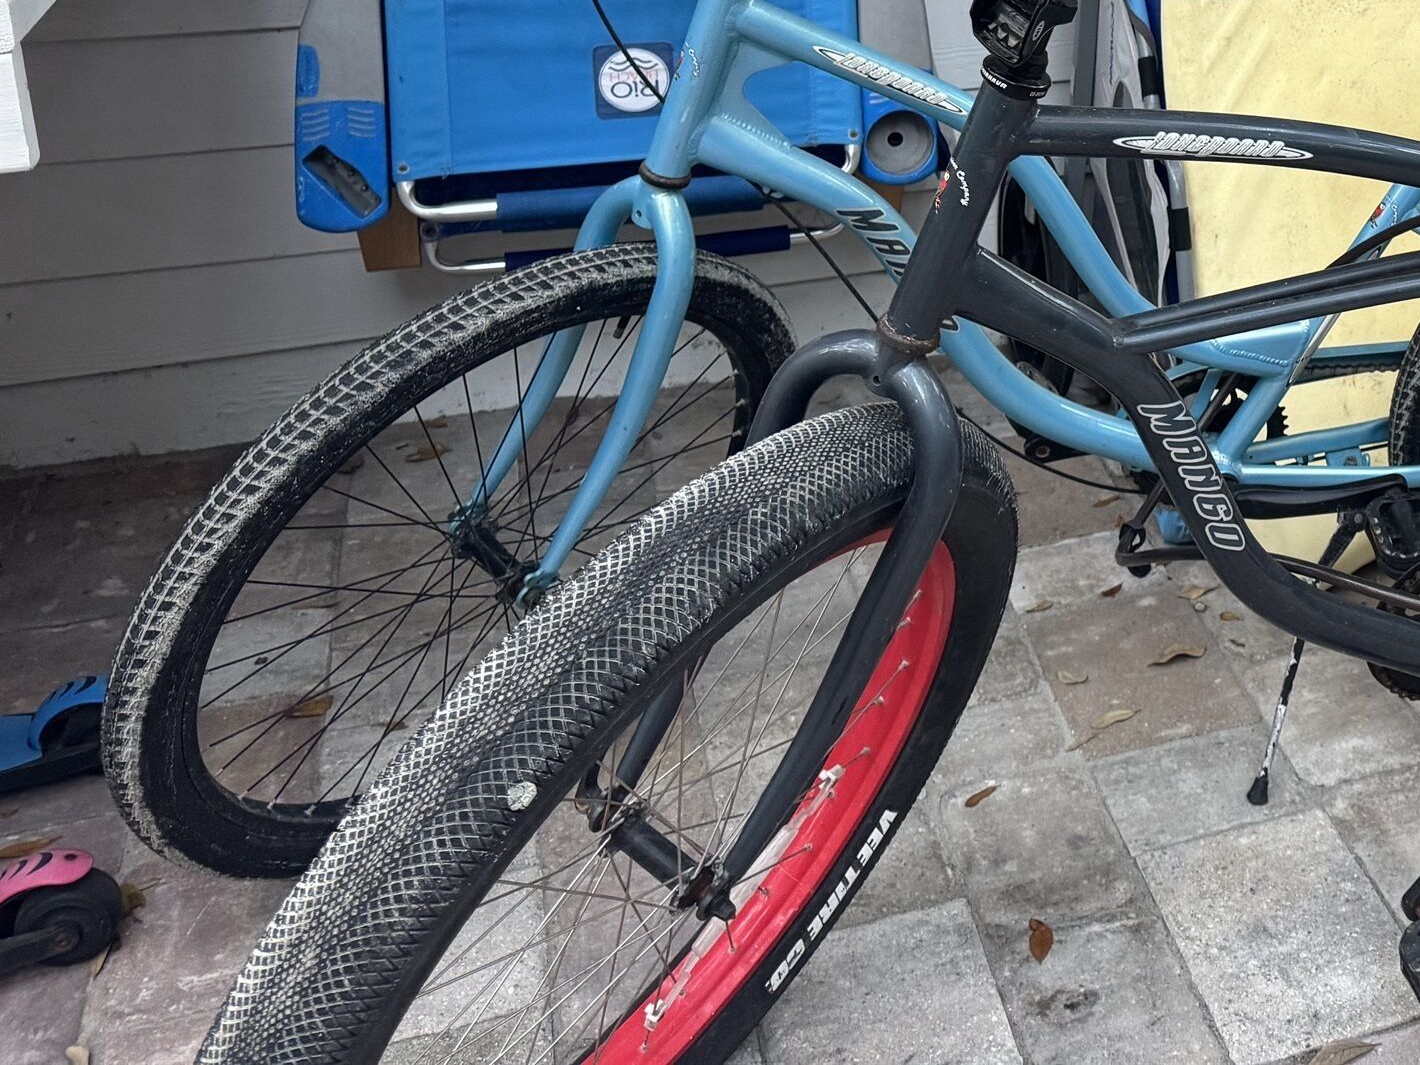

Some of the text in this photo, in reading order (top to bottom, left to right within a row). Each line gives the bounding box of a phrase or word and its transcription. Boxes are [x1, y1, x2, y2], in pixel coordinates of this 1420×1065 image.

[833, 52, 948, 106] LONGBOARD
[1140, 131, 1286, 158] LONGBOARD
[1136, 400, 1246, 552] MANGO
[856, 809, 899, 868] VEE
[806, 866, 861, 942] TIRE
